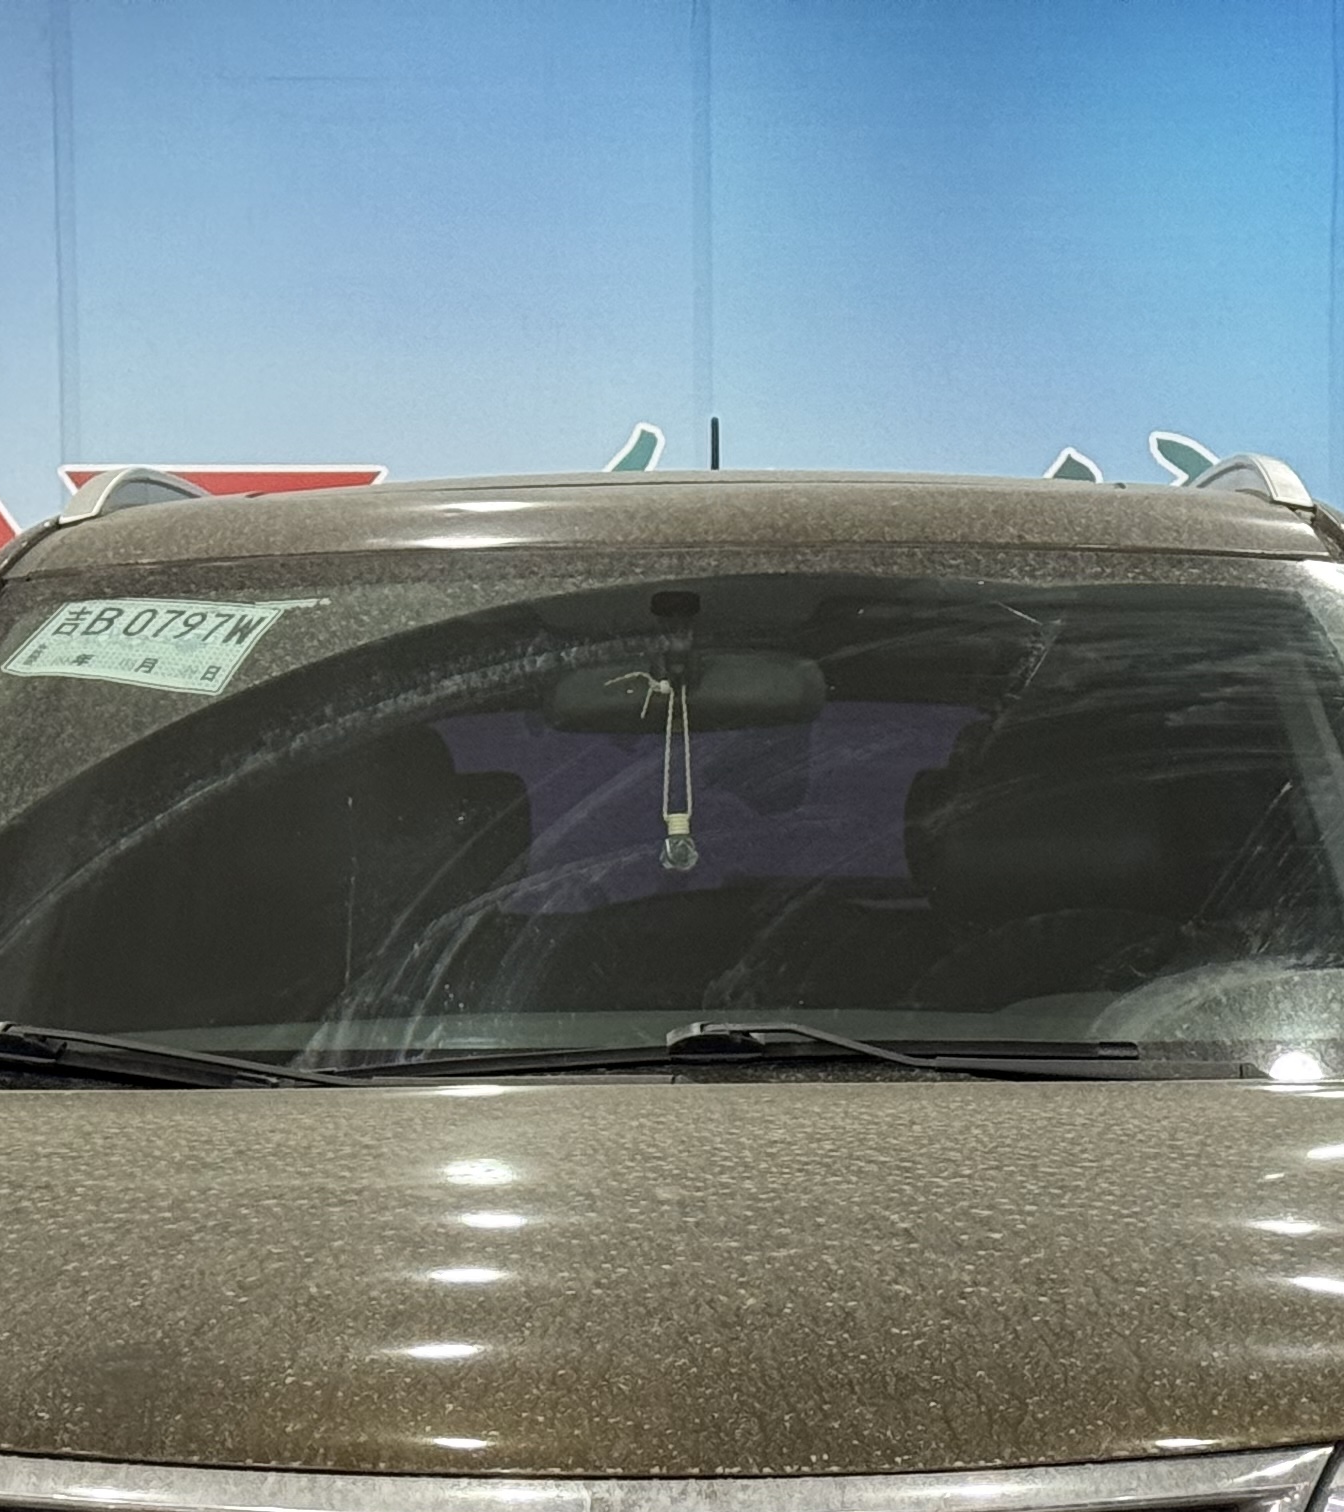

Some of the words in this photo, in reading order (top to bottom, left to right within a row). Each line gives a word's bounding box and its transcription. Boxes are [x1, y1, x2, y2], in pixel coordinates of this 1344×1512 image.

[72, 653, 95, 667] 年
[134, 657, 159, 674] 月
[199, 665, 222, 682] 日
